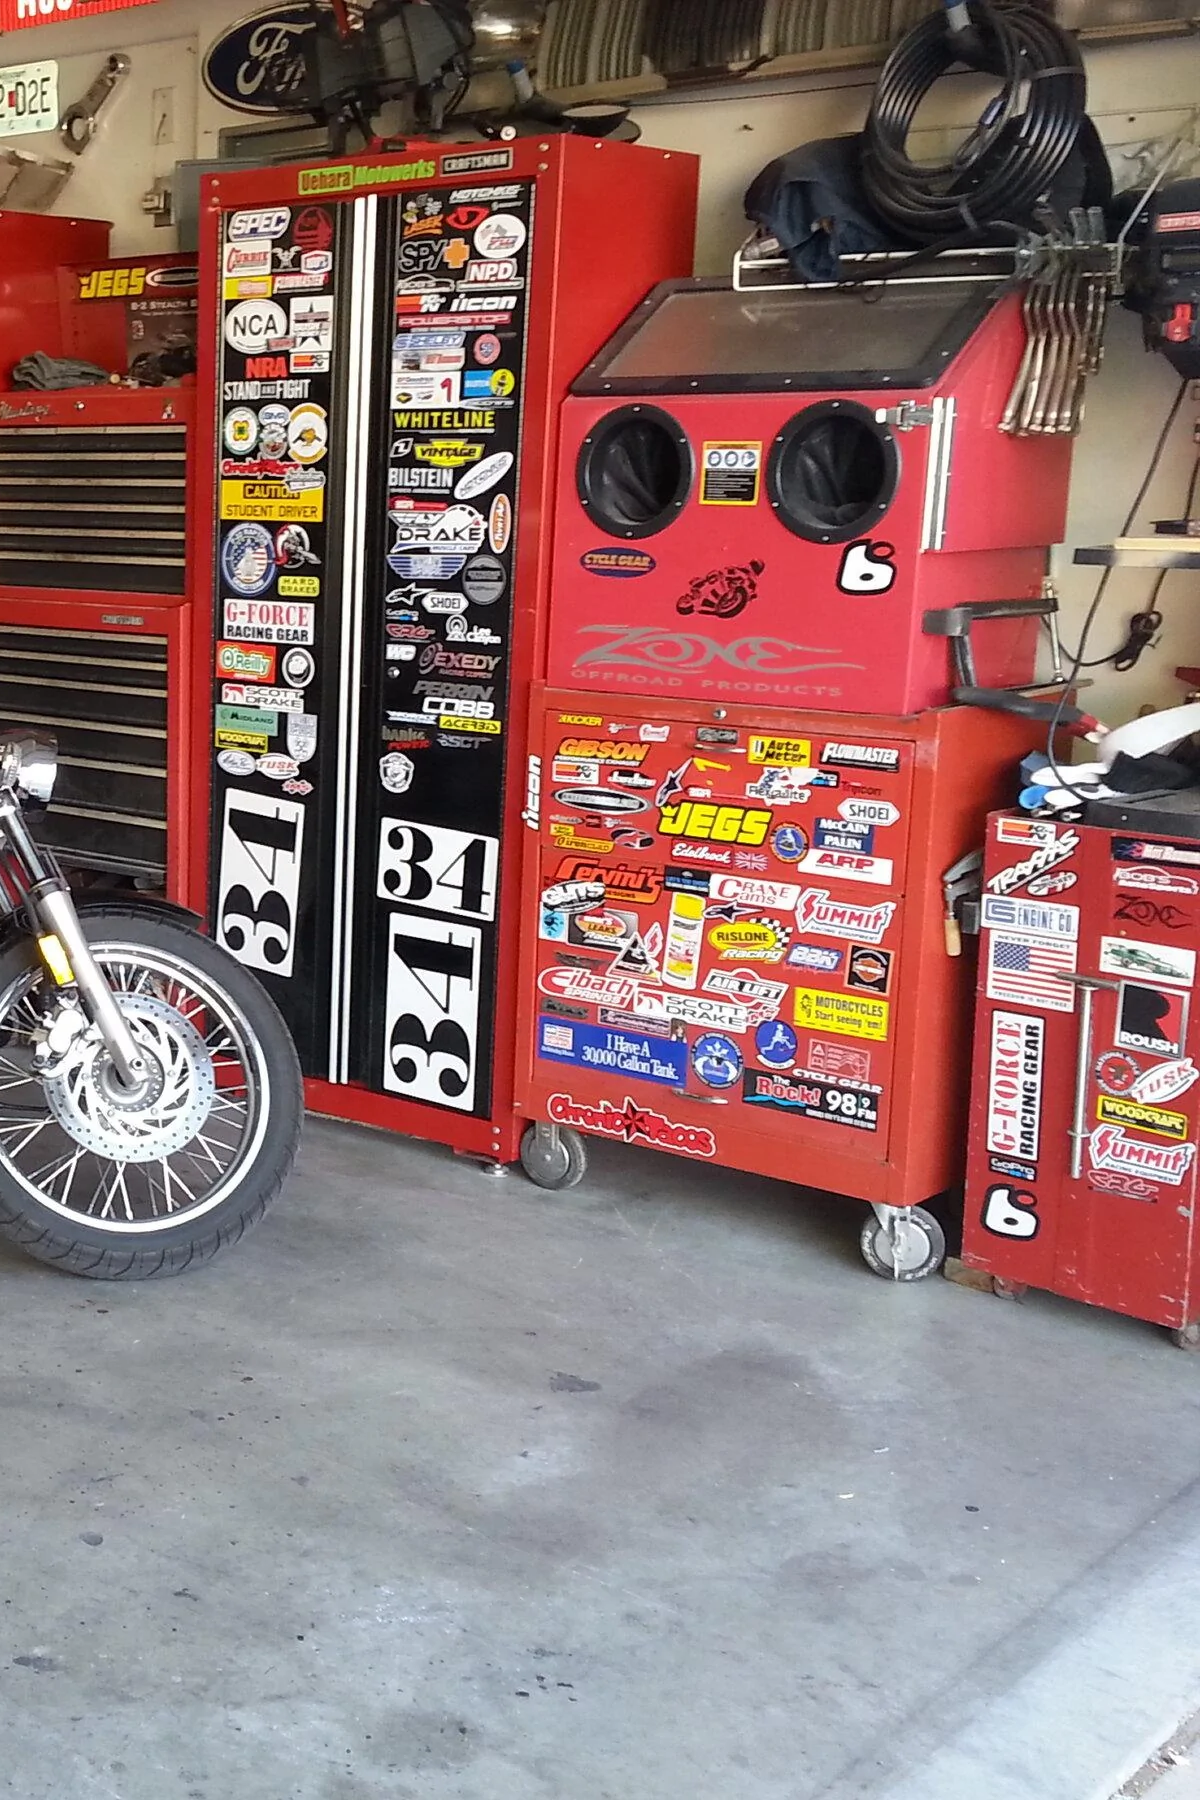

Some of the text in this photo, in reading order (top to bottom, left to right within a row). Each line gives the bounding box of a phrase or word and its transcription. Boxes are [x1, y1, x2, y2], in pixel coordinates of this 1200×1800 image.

[444, 152, 509, 172] CRAFTSMAN
[233, 214, 286, 234] SPEC
[399, 239, 448, 272] SPY
[80, 267, 147, 299] JEGS
[233, 314, 278, 337] NCA
[246, 357, 288, 378] NRA
[224, 381, 260, 400] STAND
[276, 379, 311, 399] FIGHT
[394, 411, 495, 428] WHITELINE
[421, 447, 477, 459] VINTAGE
[388, 468, 453, 488] BILSTEIN
[226, 504, 318, 518] STUDENT DRIVER
[400, 528, 481, 541] DRAKE
[584, 554, 651, 567] CYCLE GEAR
[836, 539, 896, 596] 6
[280, 586, 317, 594] BRAKES
[430, 598, 461, 609] SHOEI
[226, 602, 309, 626] G-FORCE
[227, 625, 308, 642] RACING GEAR
[434, 652, 501, 671] EXEDY
[246, 687, 301, 698] SCOTT
[412, 681, 495, 700] PERRIN
[571, 669, 843, 697] OFFROAD PRODUCTS
[246, 697, 300, 708] DRAKE
[422, 697, 495, 719] COBB
[559, 739, 650, 761] GIBSON
[767, 740, 801, 752] Auto
[821, 743, 899, 764] FLOWMASTER
[258, 761, 296, 769] TUSK
[765, 751, 807, 763] Meter
[849, 804, 889, 820] SHOEI
[659, 802, 772, 845] JEGS
[819, 819, 870, 834] McCAIN
[824, 835, 862, 850] PALIN
[383, 825, 491, 916] 34
[817, 854, 874, 869] ARP
[222, 807, 299, 964] 34
[1018, 909, 1053, 928] ENGINE
[588, 924, 617, 934] LEAKS
[716, 932, 769, 941] RISLONE
[997, 934, 1070, 949] NEVER FORGET
[564, 987, 622, 1003] SPRINGS
[710, 977, 781, 999] AIR LIFT
[390, 931, 475, 1097] 34
[666, 996, 743, 1016] SCOTT
[816, 996, 883, 1017] MOTORCYCLES
[665, 1006, 744, 1027] DRAKE
[815, 1011, 834, 1022] Start
[837, 1014, 862, 1028] seeing
[607, 1034, 651, 1057] I Have A
[1121, 1032, 1179, 1054] ROUSH
[618, 1053, 651, 1073] Gallon
[772, 1075, 791, 1086] The
[793, 1069, 883, 1094] CYCLE GEAR
[992, 1020, 1021, 1151] G-FORCE
[1019, 1023, 1040, 1156] RACING GEAR
[1134, 1061, 1190, 1100] TUSK
[756, 1076, 822, 1106] Rock!
[826, 1090, 857, 1115] 98
[858, 1108, 876, 1120] FM
[1104, 1100, 1183, 1130] WOODCRAFT
[991, 1157, 1035, 1174] GoPro
[980, 1183, 1041, 1241] 6
